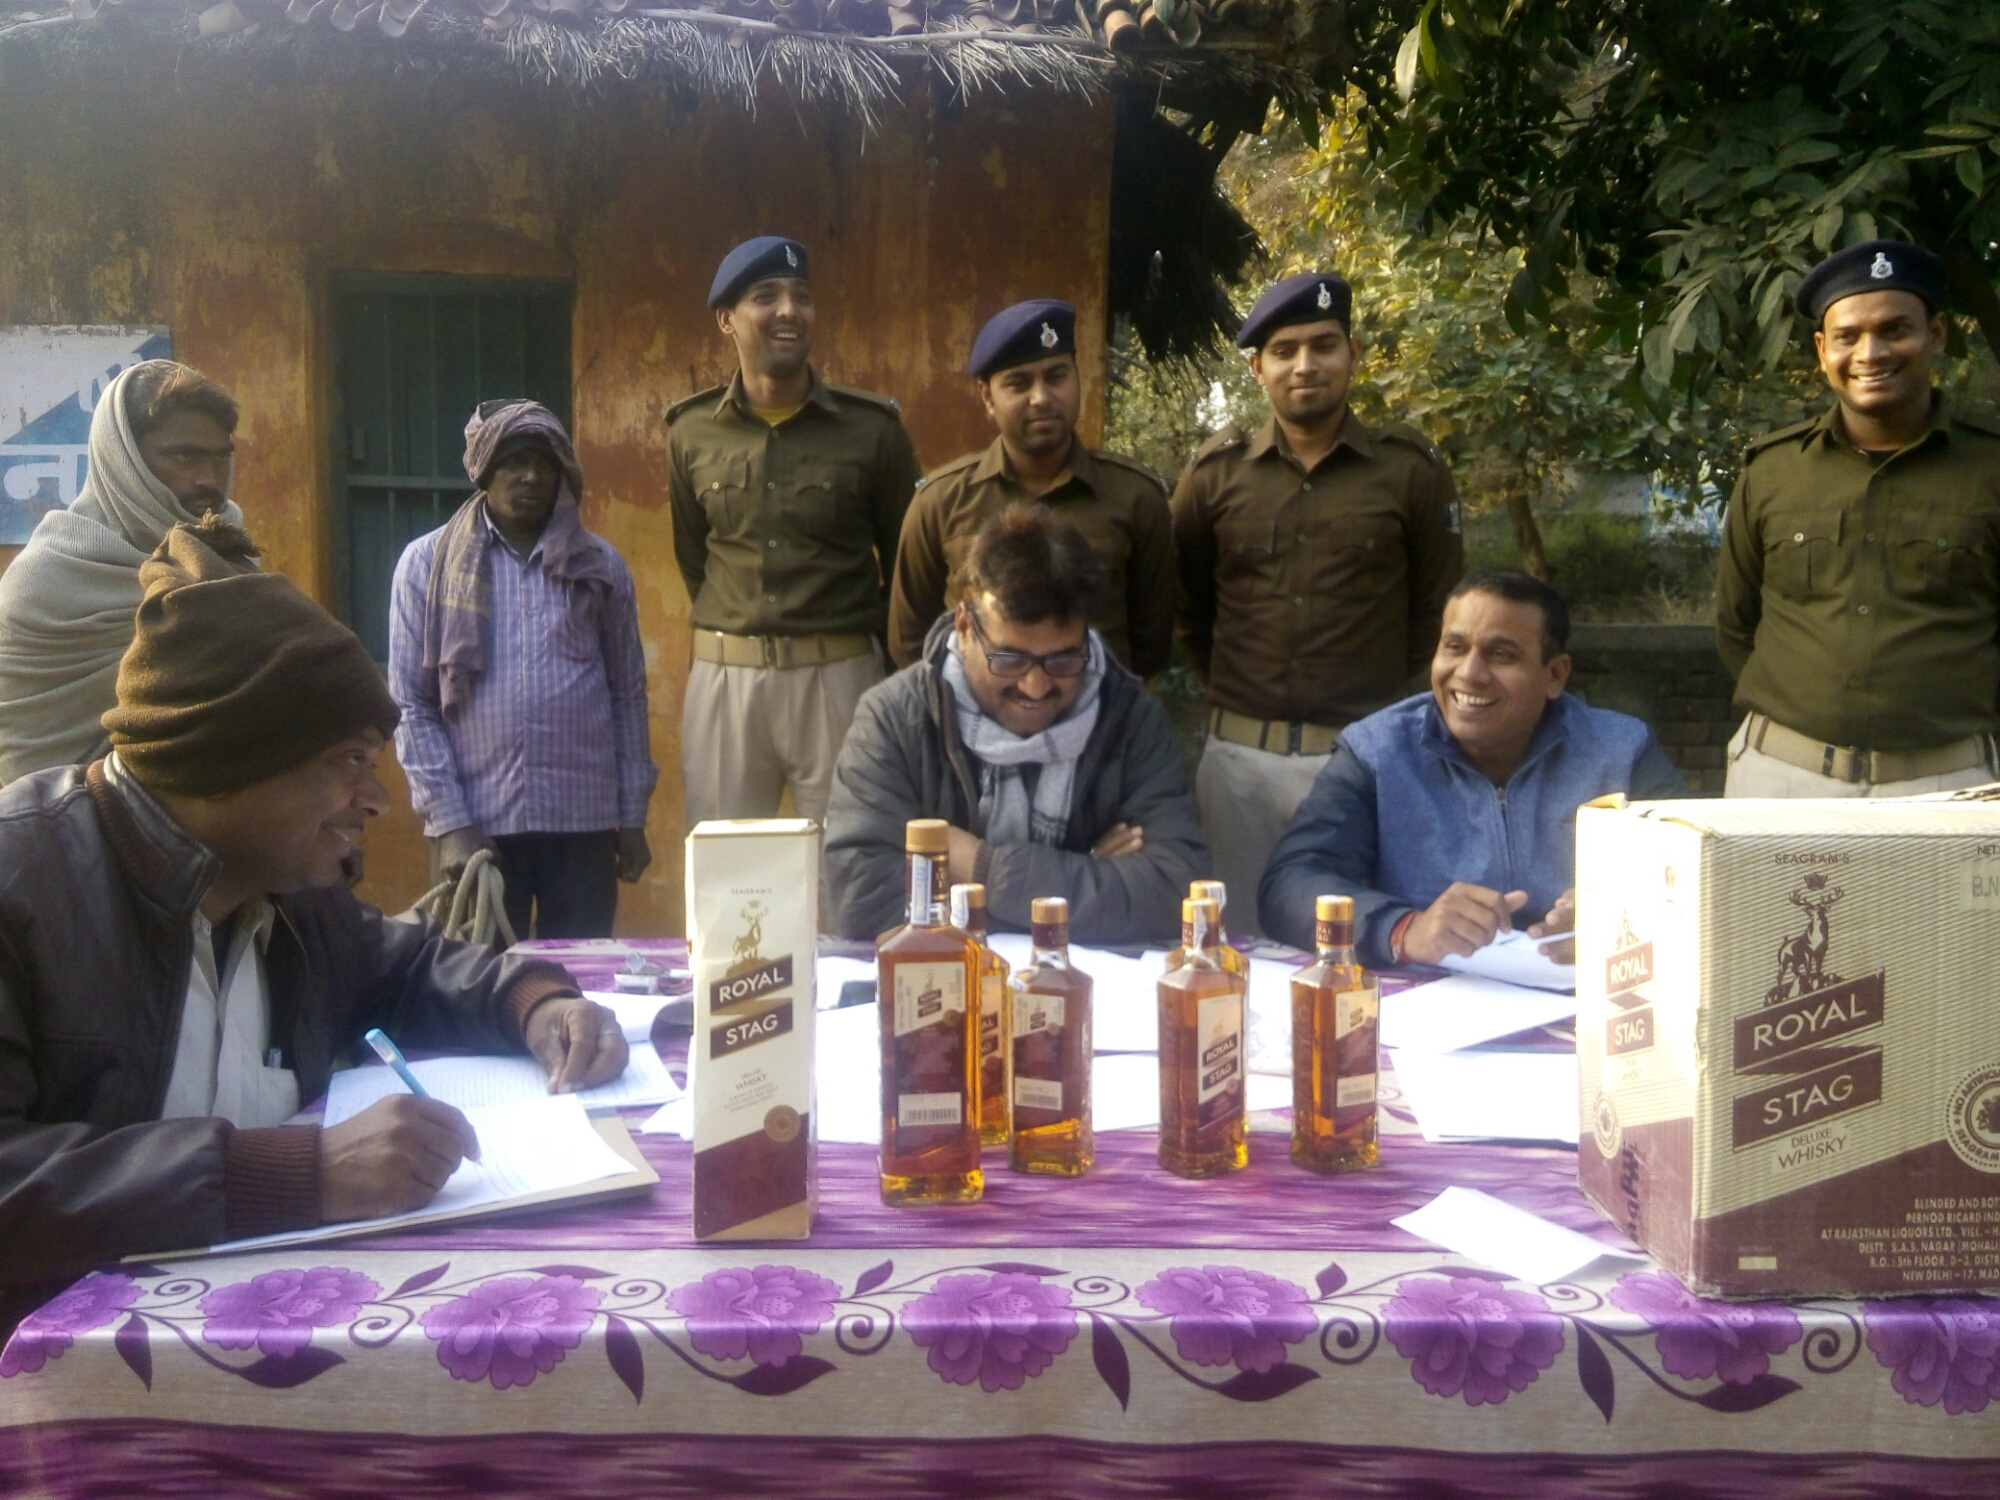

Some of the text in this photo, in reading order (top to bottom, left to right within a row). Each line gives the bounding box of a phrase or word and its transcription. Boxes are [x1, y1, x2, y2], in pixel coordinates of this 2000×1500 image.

[1774, 853, 1850, 864] SEAGRAM'S
[1610, 953, 1648, 985] ROYAL
[719, 967, 784, 1003] ROYAL
[725, 1014, 778, 1046] STAG
[1614, 1018, 1645, 1046] STAG
[1753, 993, 1867, 1050] ROYAL
[1206, 1040, 1234, 1063] ROYAL
[1209, 1063, 1232, 1084] STAG
[1763, 1074, 1853, 1126] STAG
[1791, 1129, 1833, 1149] DELUXE
[1778, 1135, 1847, 1169] WHISKY
[1914, 1197, 1956, 1209] BLENDED
[1958, 1197, 1979, 1209] AND
[1905, 1212, 1945, 1223] PERNOD
[1946, 1211, 1981, 1223] RICARD
[1834, 1227, 1890, 1240] RAJASTHAN
[1892, 1227, 1934, 1239] LIQUORS
[1921, 1241, 1955, 1252] NAGAR
[1902, 1270, 1924, 1280] NEW
[1926, 1269, 1952, 1280] DELHI
